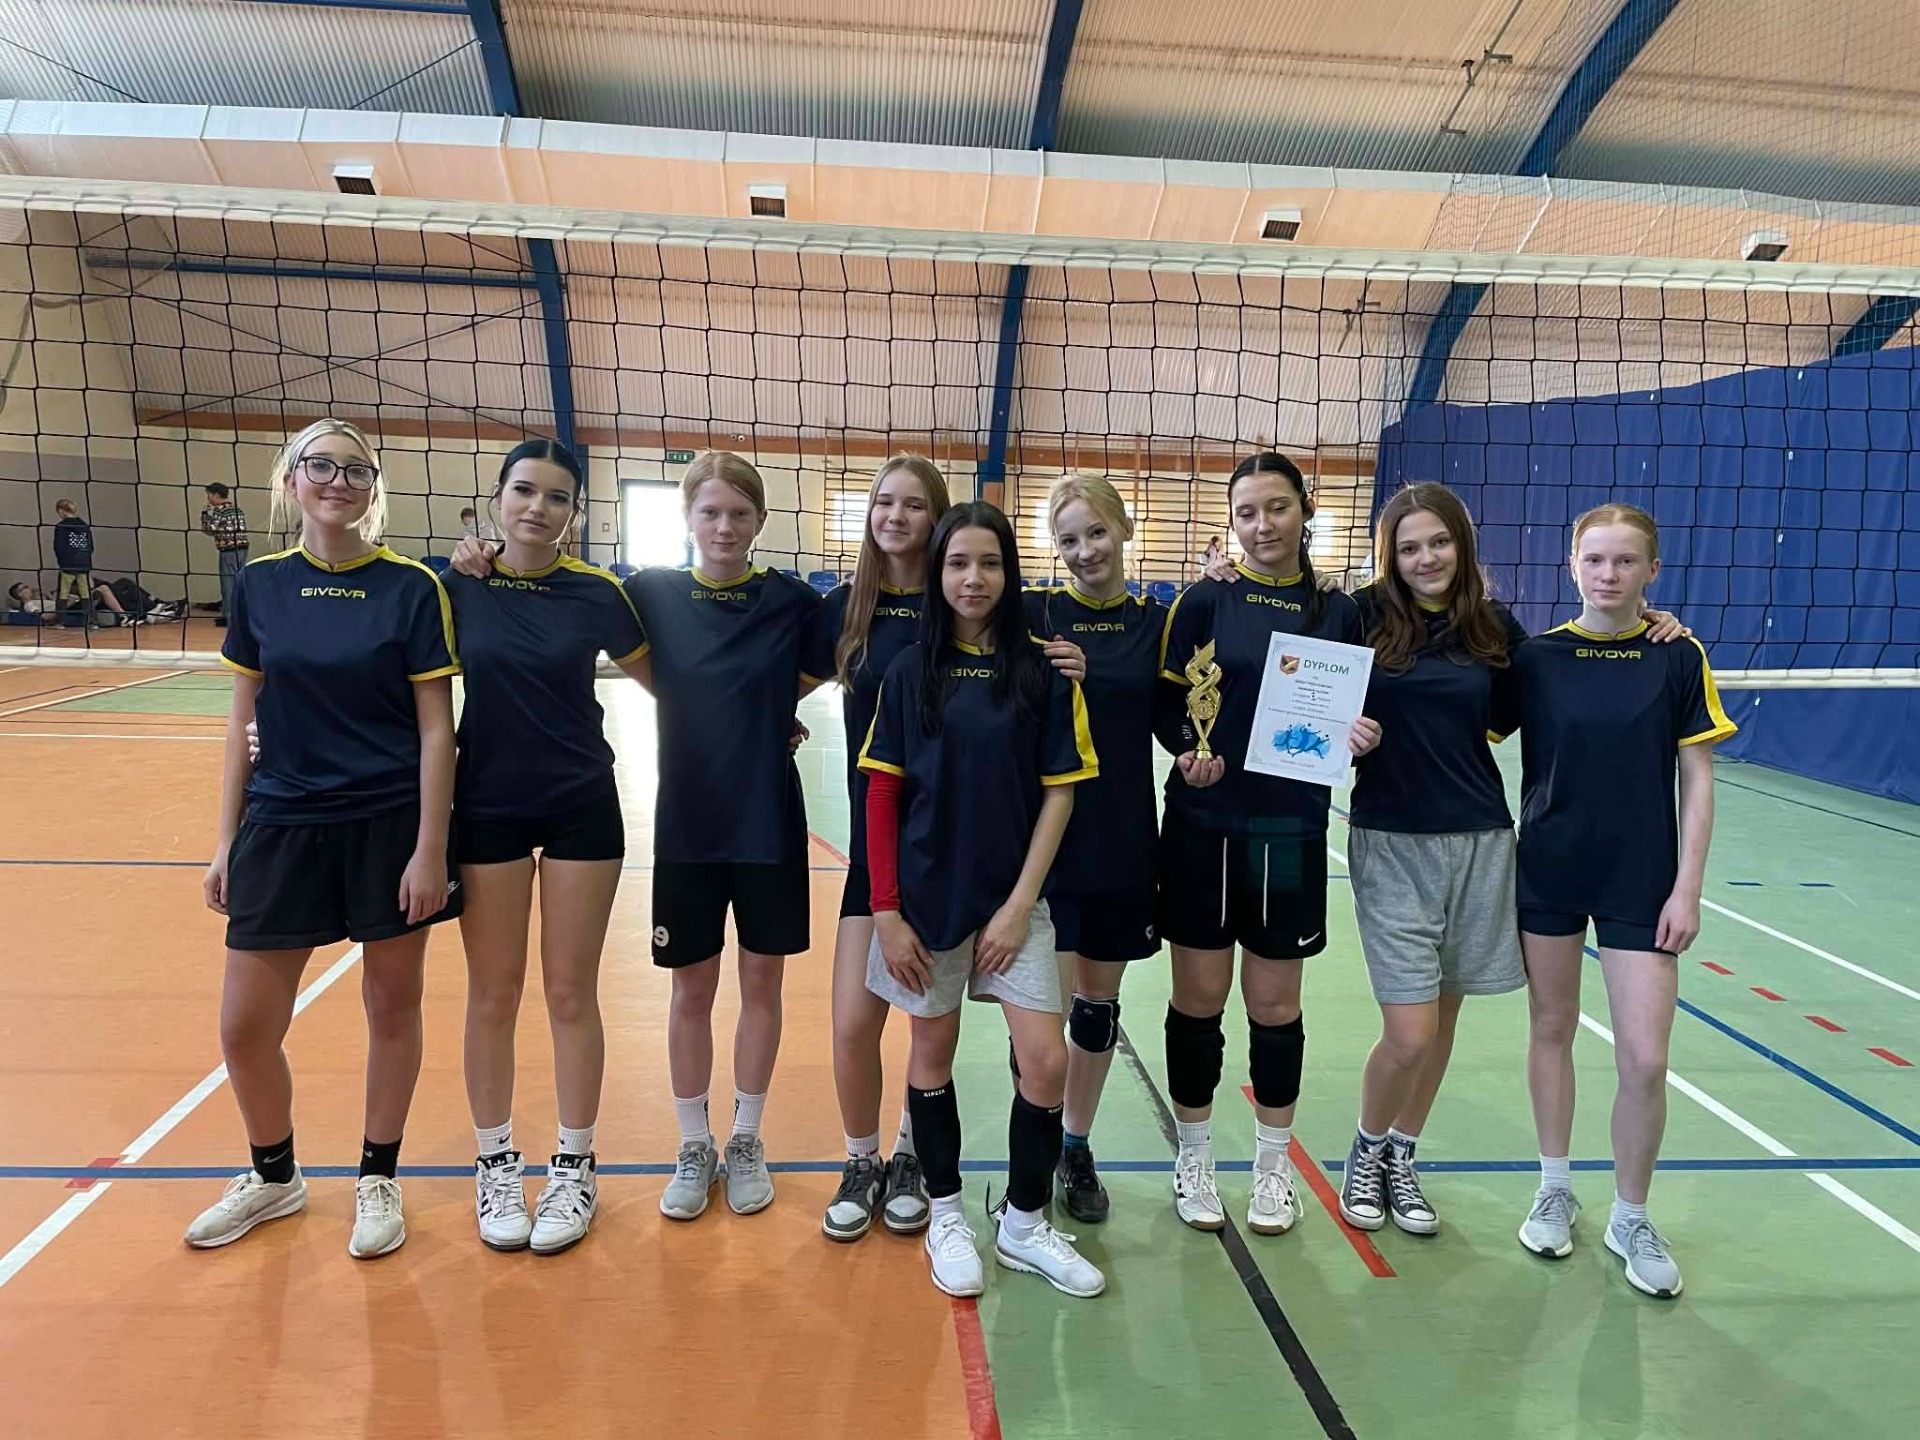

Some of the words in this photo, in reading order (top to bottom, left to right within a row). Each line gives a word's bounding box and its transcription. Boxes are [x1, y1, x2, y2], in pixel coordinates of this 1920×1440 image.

[301, 587, 366, 599] GIVOVA
[691, 591, 747, 601] GIVOVA
[1246, 593, 1302, 612] GIVOVA
[875, 607, 922, 619] GIVOV
[1072, 623, 1125, 632] GIVOVA
[1575, 648, 1642, 659] GIVOVA
[1303, 659, 1349, 675] DYPLOM
